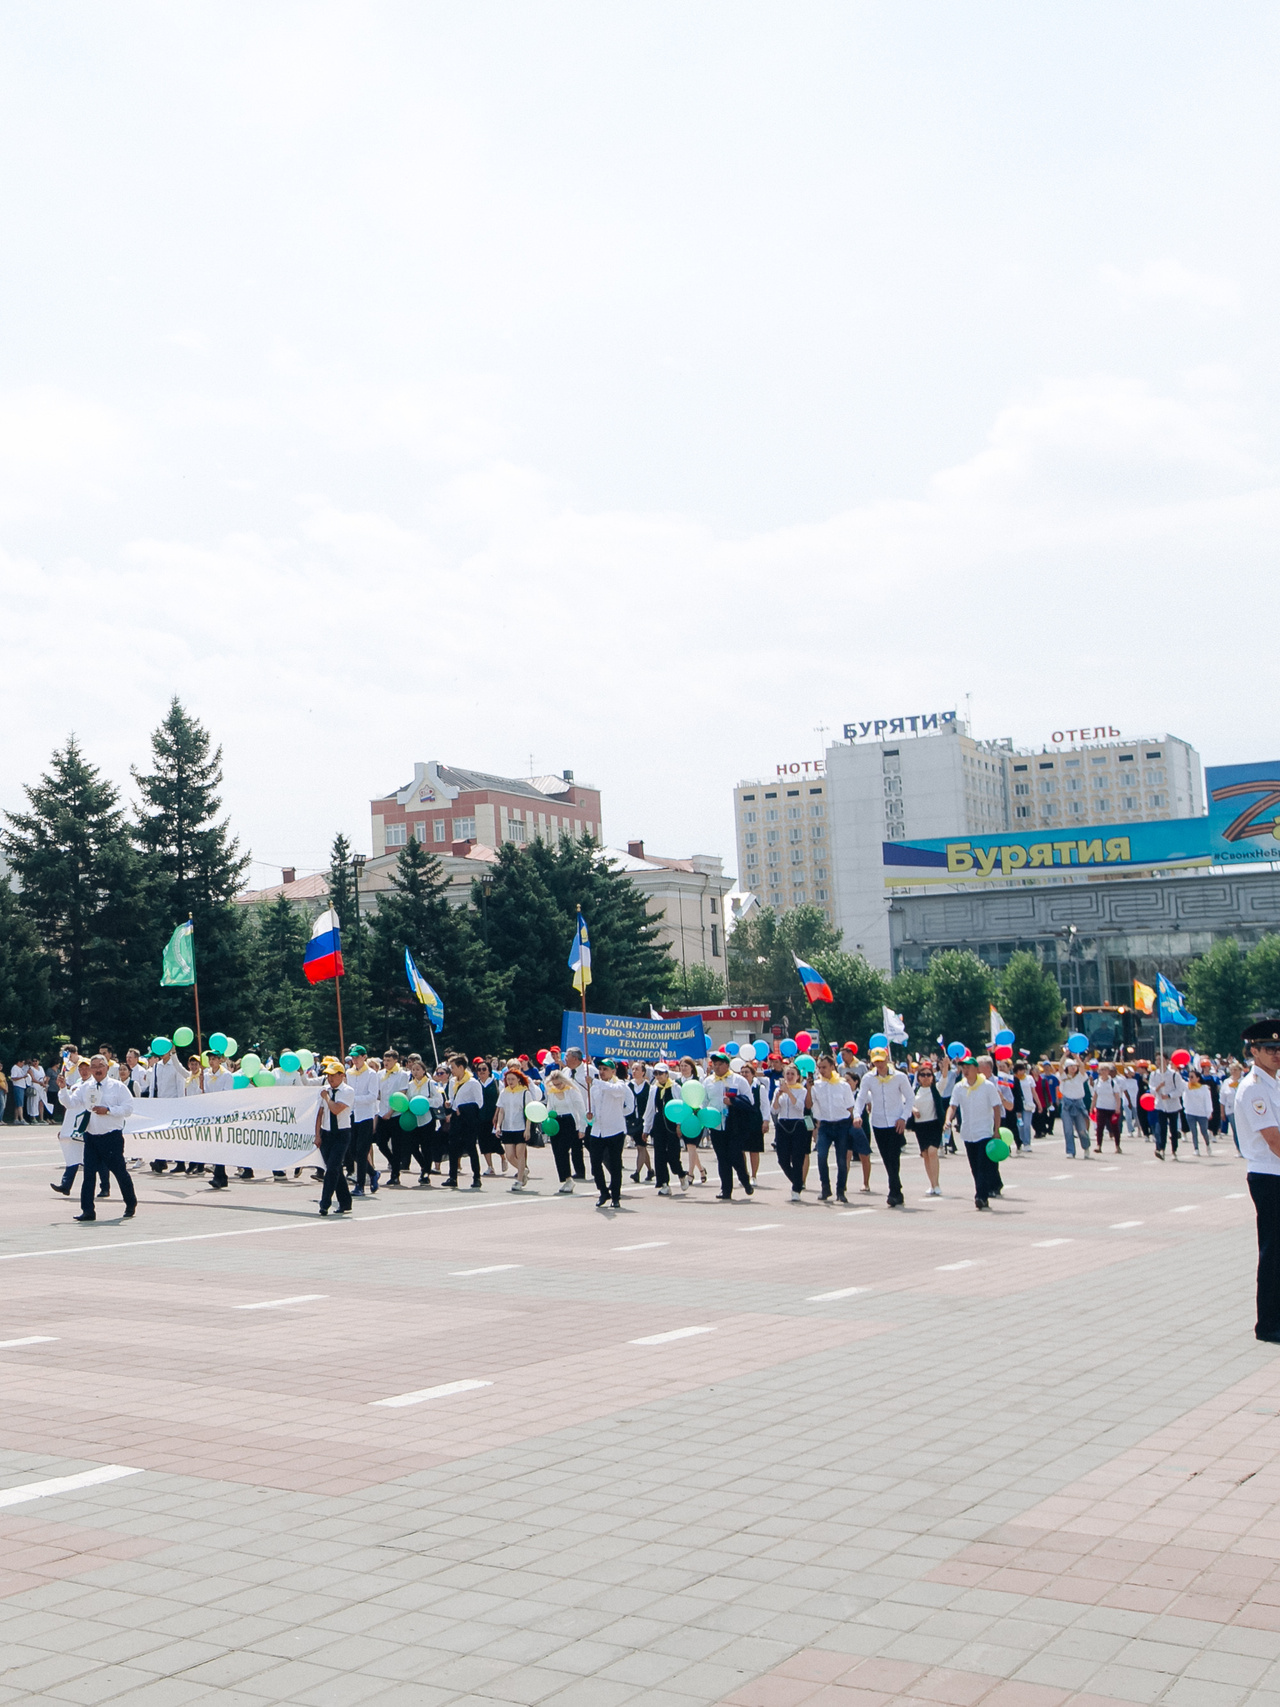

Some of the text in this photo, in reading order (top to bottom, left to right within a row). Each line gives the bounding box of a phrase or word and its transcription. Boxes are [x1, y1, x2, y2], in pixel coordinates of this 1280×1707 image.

[843, 710, 956, 739] БУРЯТИЯ
[1051, 725, 1121, 743] ОТЕЛЬ
[776, 760, 826, 775] HOTE
[945, 836, 1131, 876] Бурятия
[1214, 848, 1280, 860] #СвоихНеБ
[605, 1018, 681, 1031] УЛАН-УДЭНСКИЙ
[619, 1039, 668, 1049] ТЕХНИКУМ
[215, 1127, 223, 1143] И
